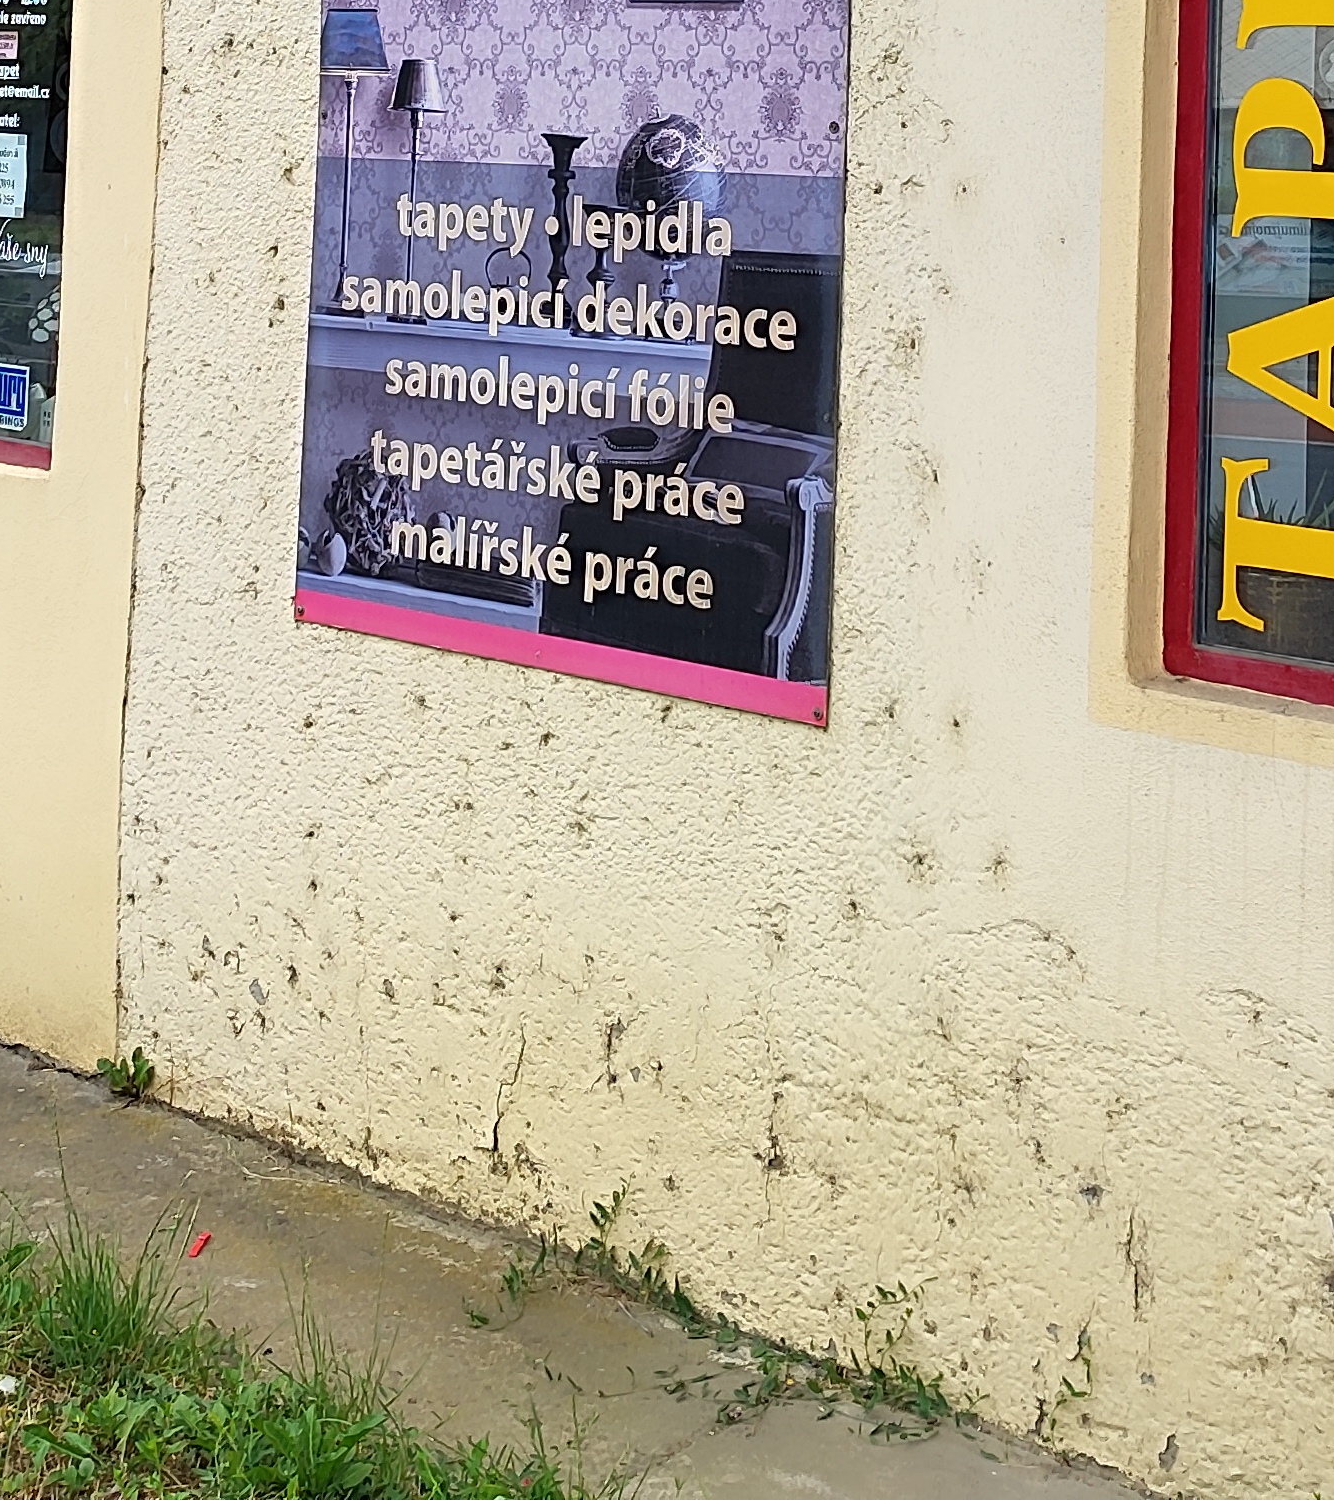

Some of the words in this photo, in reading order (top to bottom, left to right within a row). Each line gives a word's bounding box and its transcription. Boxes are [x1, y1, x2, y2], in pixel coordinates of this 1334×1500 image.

[23, 243, 49, 279] sny
[397, 193, 535, 258] tapety
[571, 195, 733, 263] lepidla
[340, 269, 567, 337] samolepicí
[576, 280, 798, 351] dekorace
[385, 355, 618, 425] samolepicí
[628, 369, 736, 434] fólie
[369, 429, 602, 504] tapetářské
[612, 461, 746, 525] práce
[390, 516, 573, 586] malířské
[582, 546, 714, 610] práce
